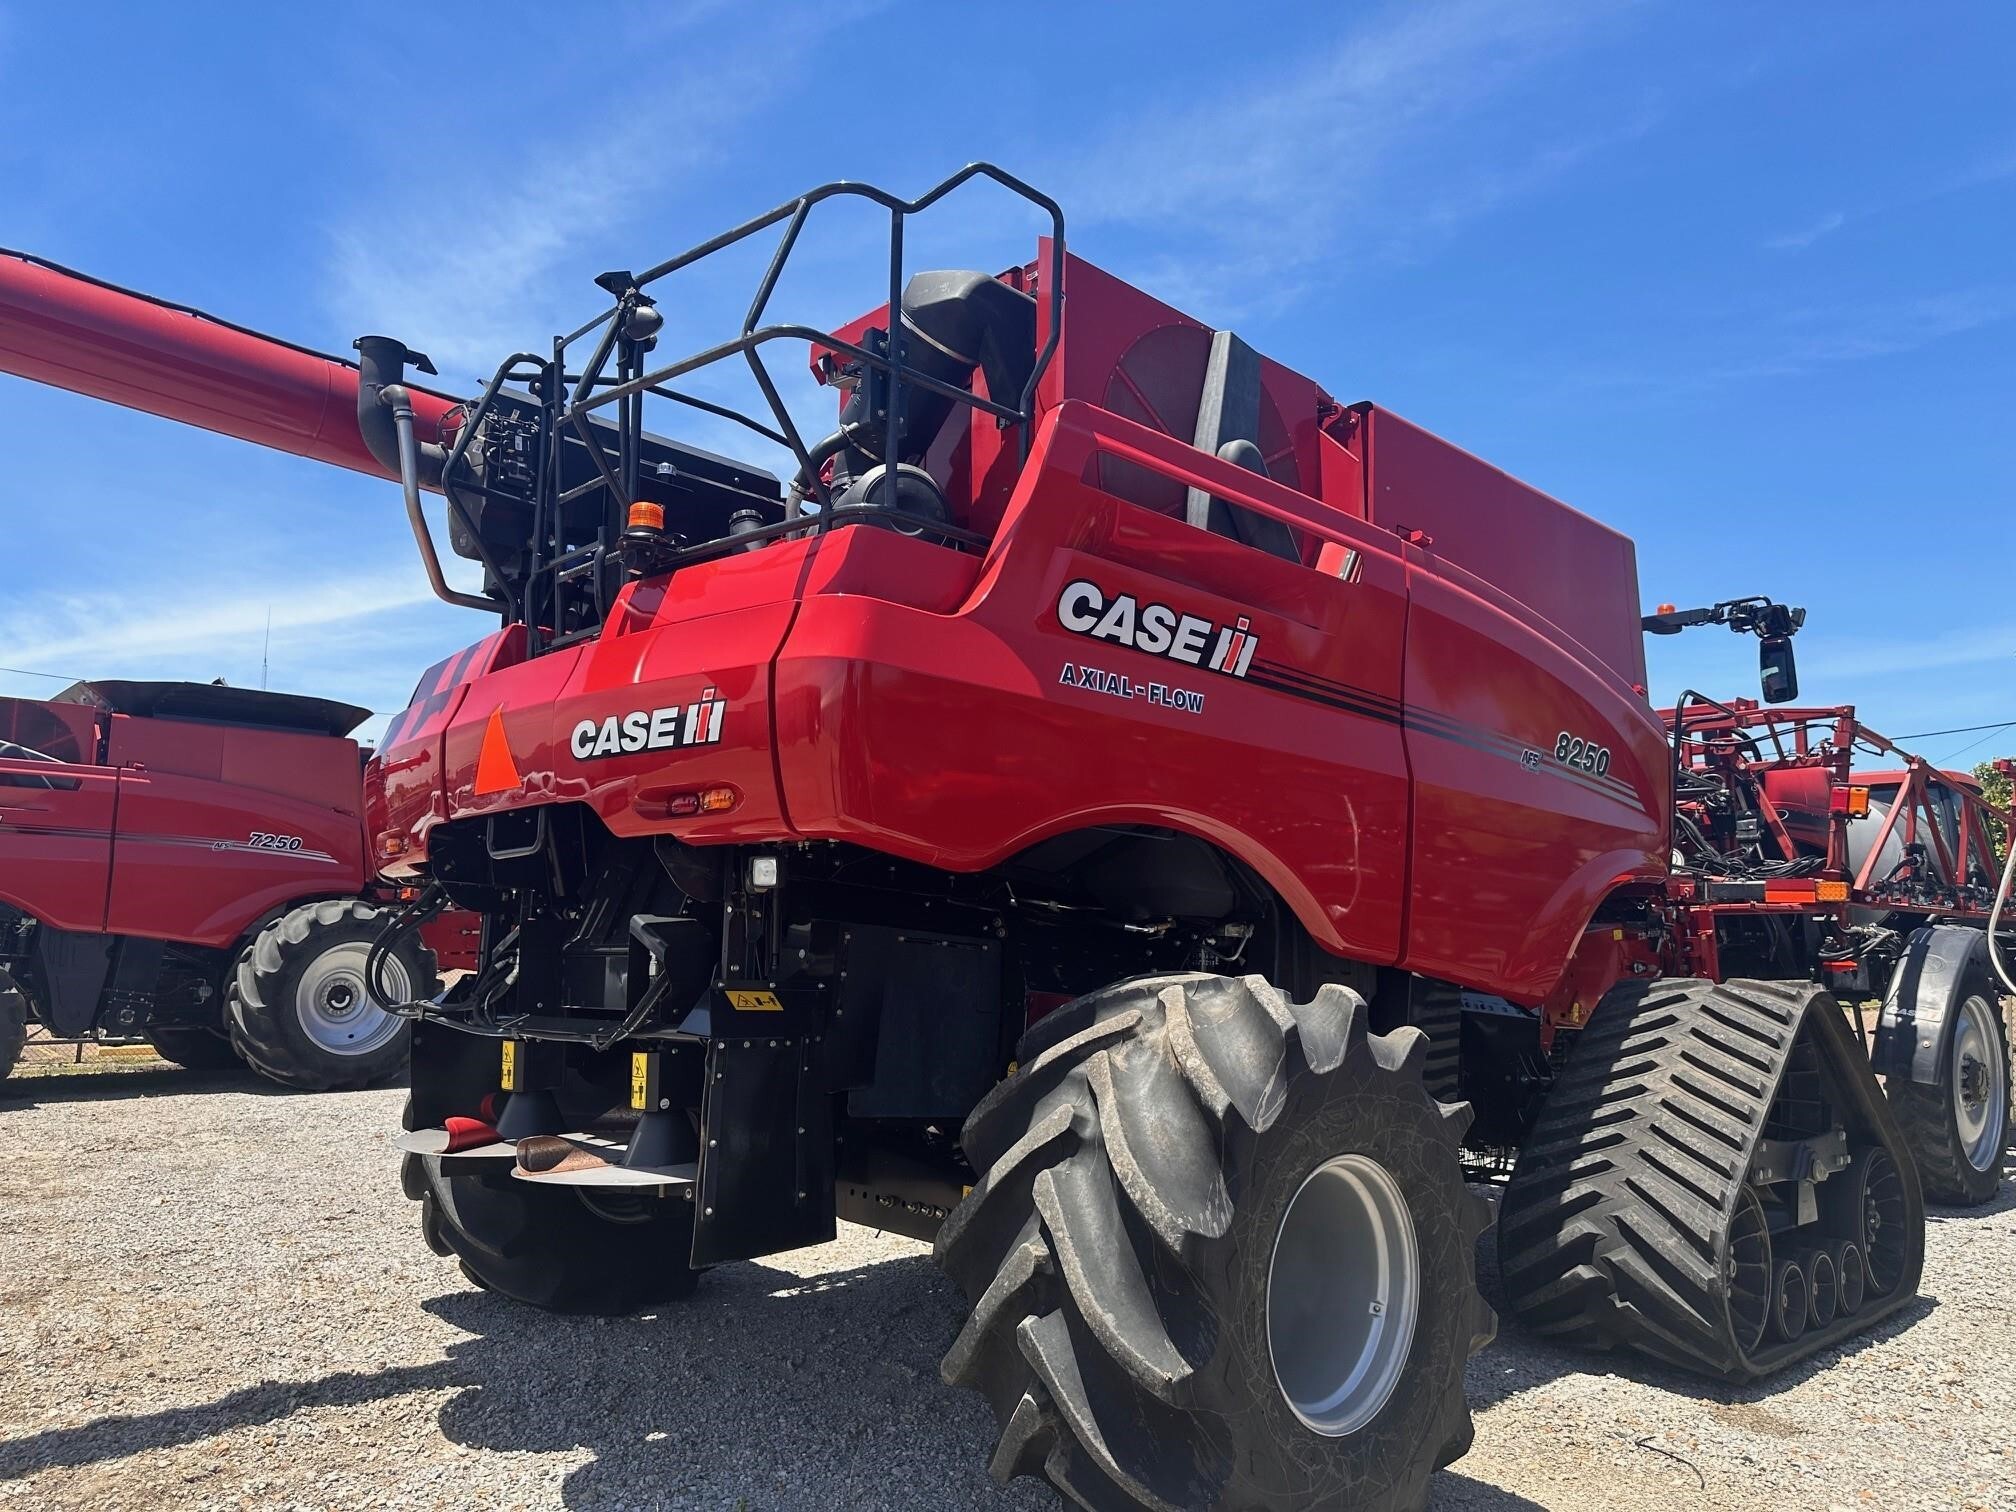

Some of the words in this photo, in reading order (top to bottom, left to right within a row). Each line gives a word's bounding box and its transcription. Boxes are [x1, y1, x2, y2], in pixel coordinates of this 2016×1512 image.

[1057, 581, 1213, 665] CASE
[570, 705, 680, 759] CASE
[1520, 748, 1541, 768] AFS
[1554, 731, 1611, 778] 8250
[248, 831, 303, 851] 7250
